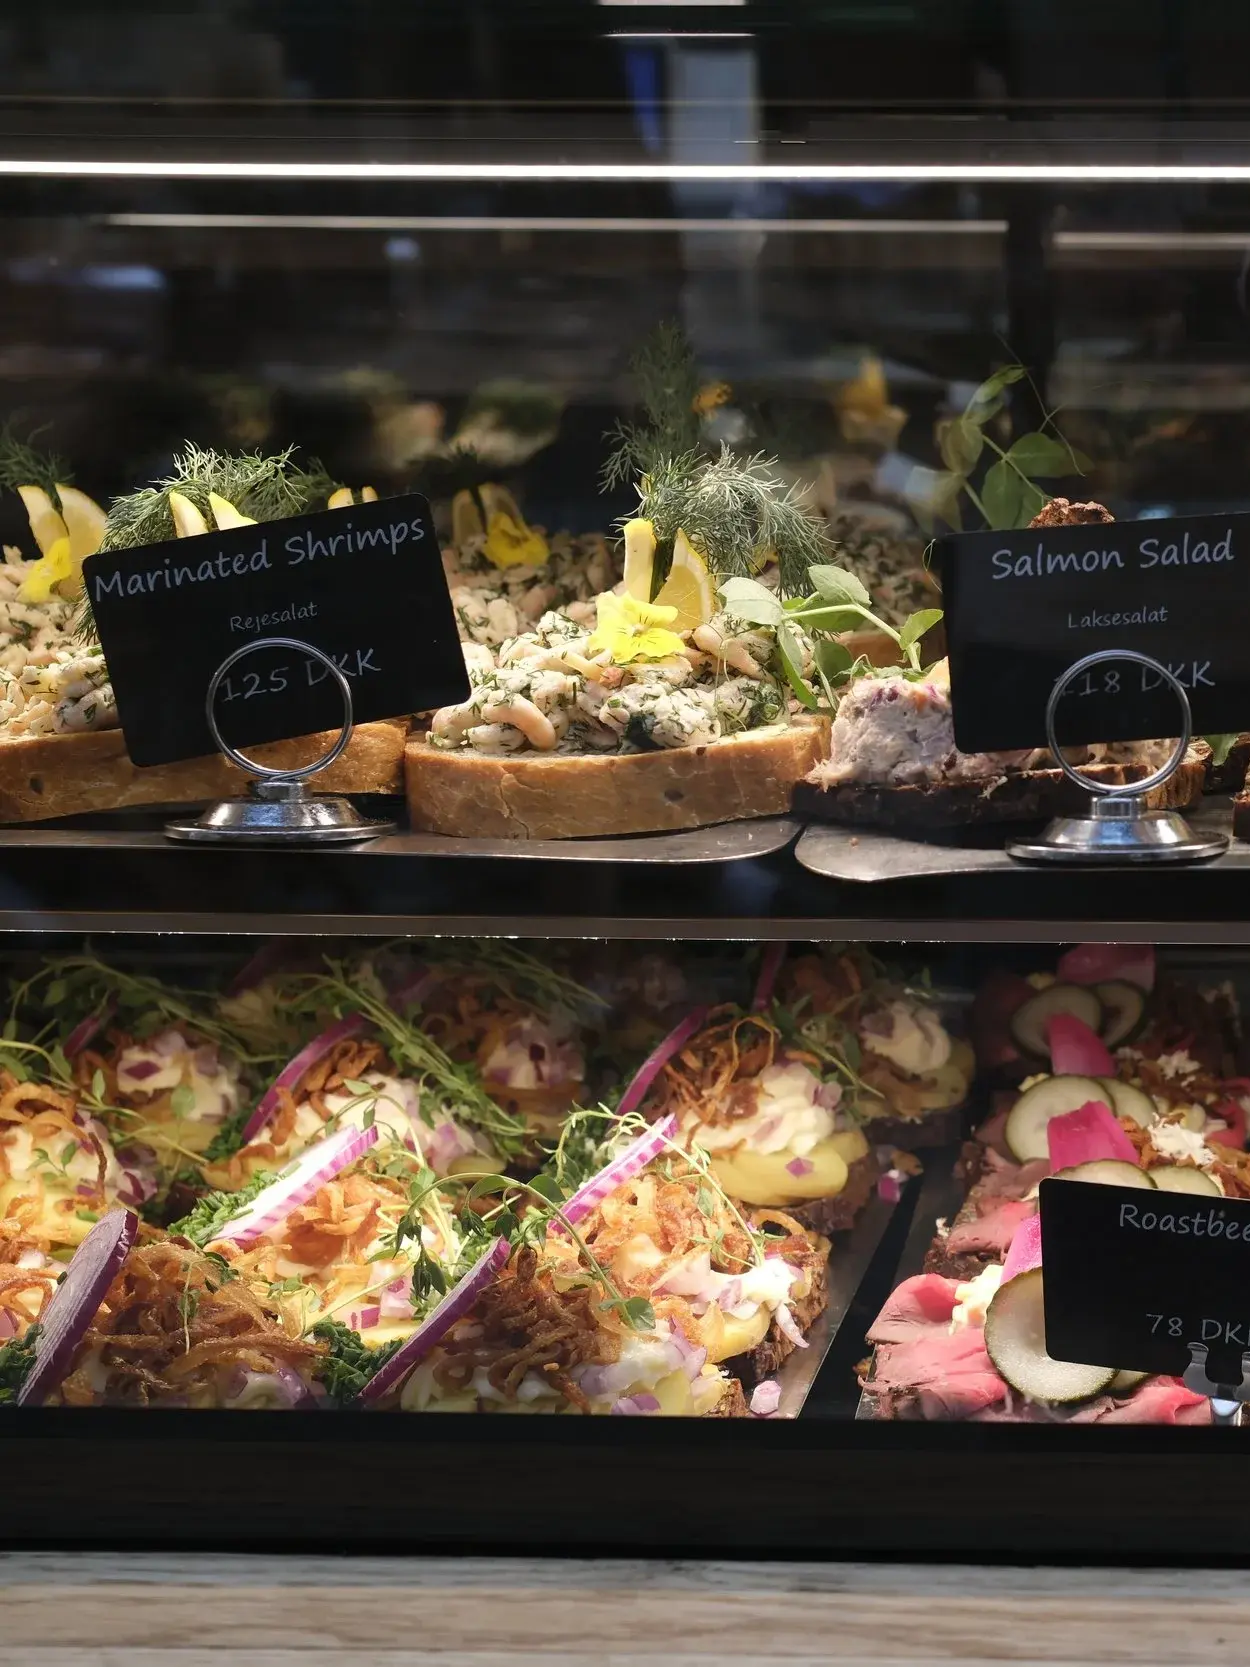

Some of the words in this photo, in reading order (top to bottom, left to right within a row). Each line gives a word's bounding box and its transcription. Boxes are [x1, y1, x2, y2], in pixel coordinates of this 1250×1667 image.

[95, 538, 272, 602] Marinated
[285, 516, 425, 566] Shrimps
[991, 542, 1125, 580] Salmon
[1139, 529, 1235, 569] Salad
[229, 601, 318, 634] Rejesalat
[1067, 605, 1169, 629] Laksesalat
[218, 666, 290, 703] 125
[304, 647, 382, 687] DKK
[1141, 660, 1216, 692] DKK
[1146, 1313, 1183, 1337] 78
